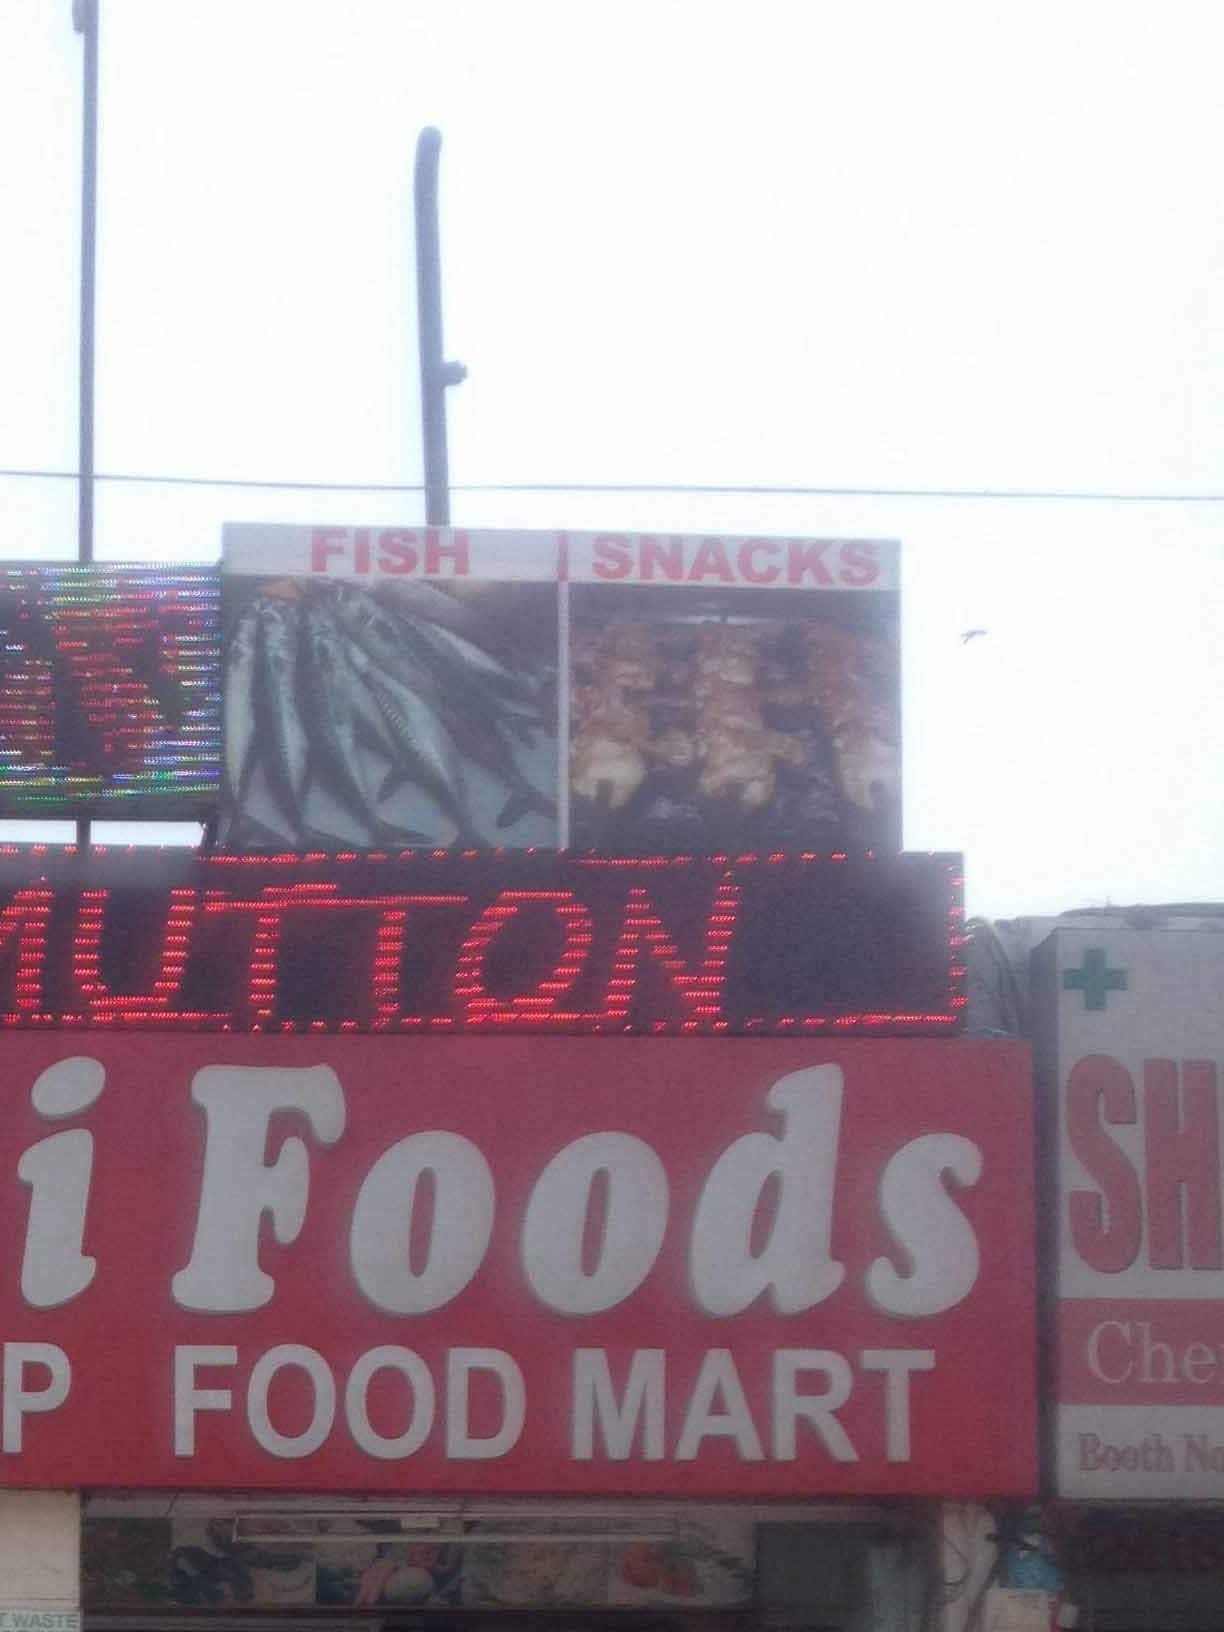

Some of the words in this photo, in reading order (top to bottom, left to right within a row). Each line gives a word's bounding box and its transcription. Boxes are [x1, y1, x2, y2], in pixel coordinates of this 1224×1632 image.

[310, 525, 470, 575] FISH
[592, 534, 879, 587] SNACKS
[171, 1062, 984, 1320] Foods
[1088, 1319, 1224, 1385] Che
[173, 1343, 528, 1460] FOOD
[571, 1347, 936, 1463] MART
[1079, 1432, 1175, 1472] Booth
[13, 1612, 77, 1629] WASTE
